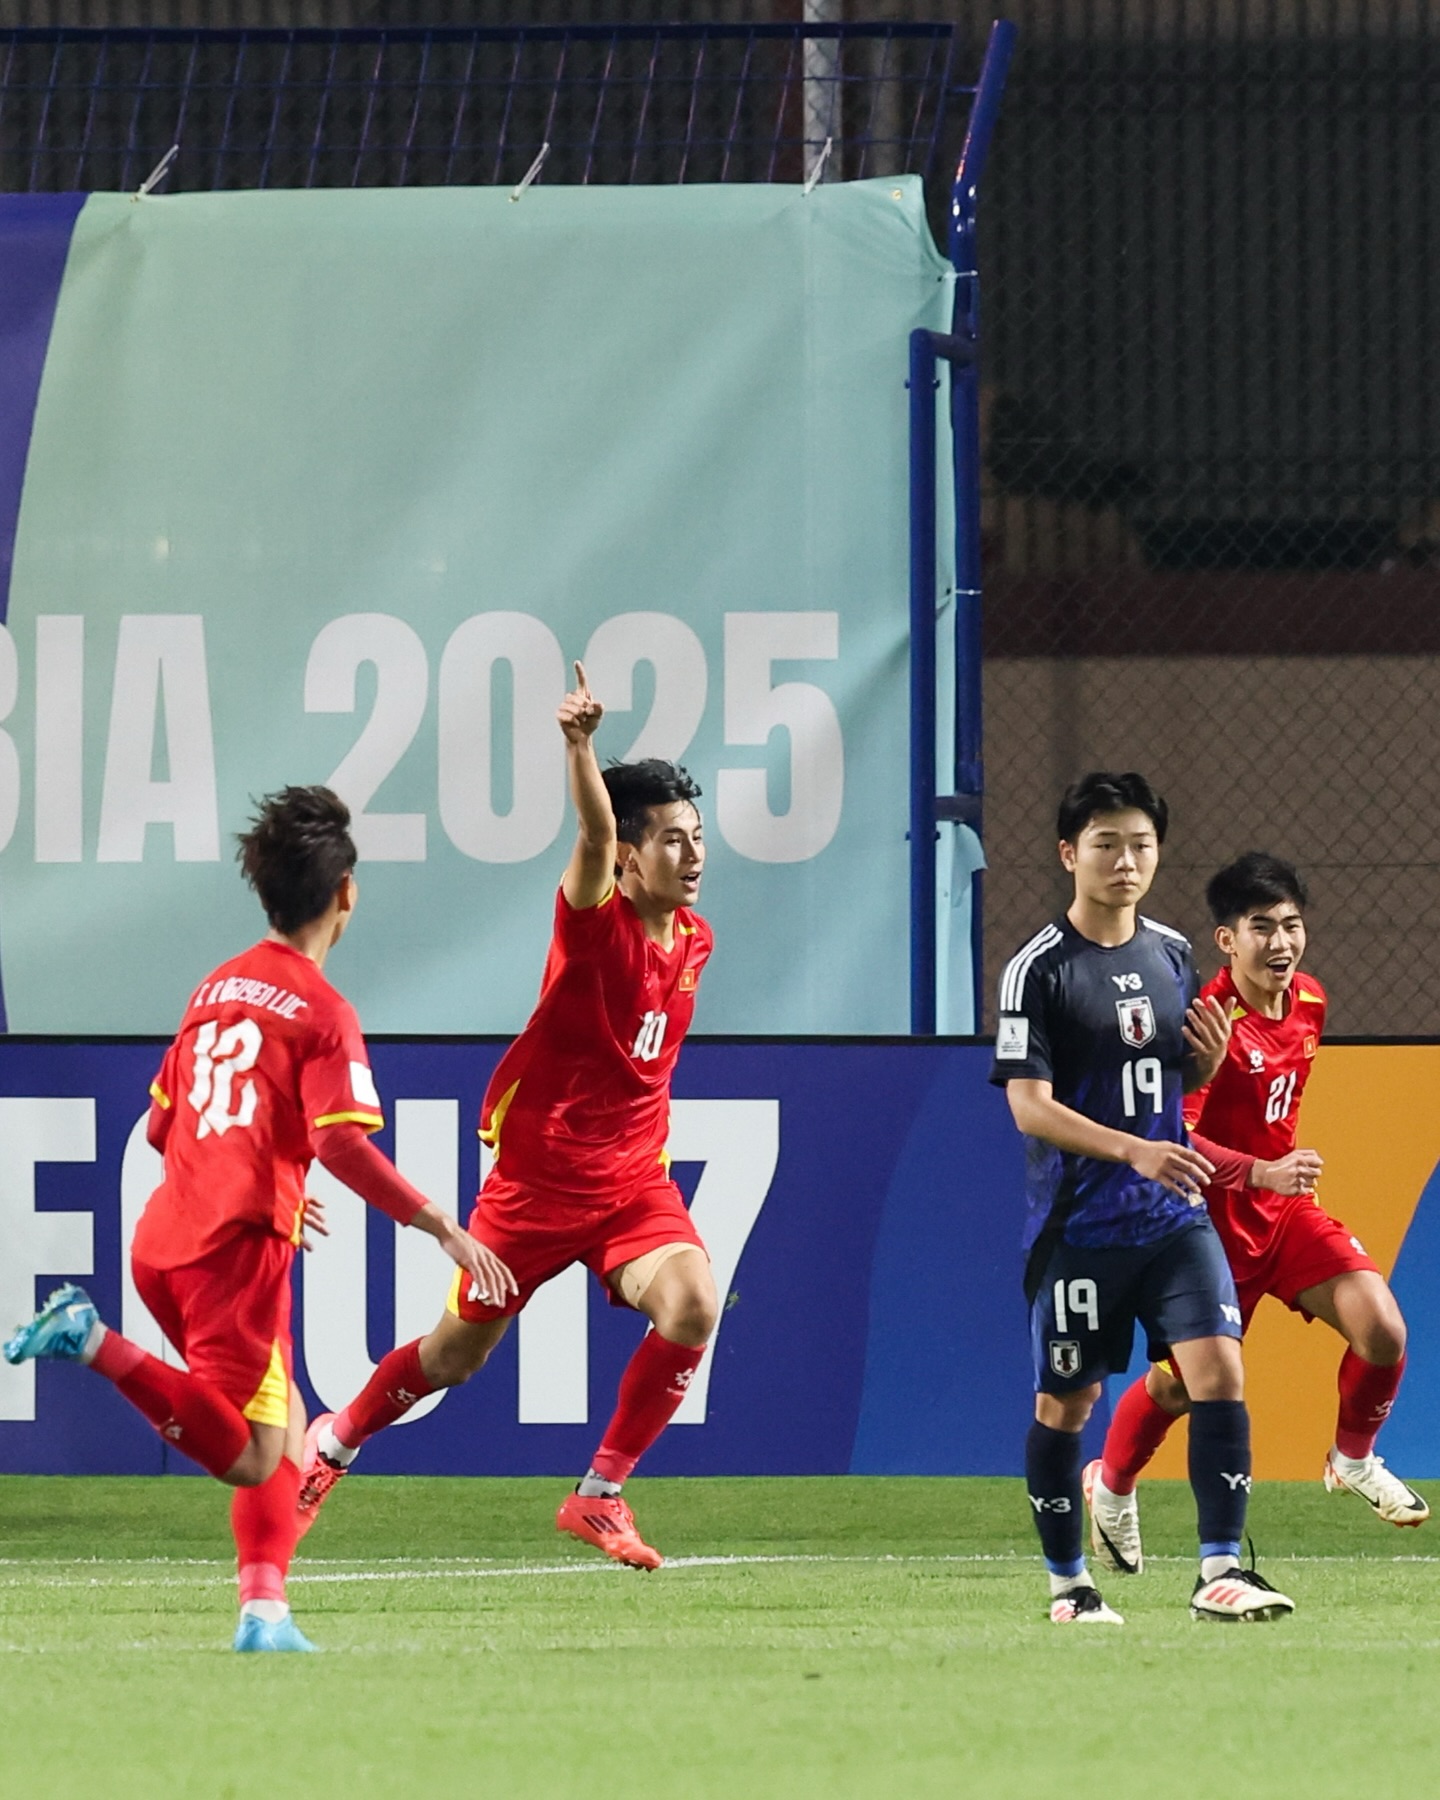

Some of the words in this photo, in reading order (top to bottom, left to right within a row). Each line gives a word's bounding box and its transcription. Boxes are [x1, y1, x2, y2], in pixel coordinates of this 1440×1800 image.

[0, 613, 221, 862] IA
[304, 610, 844, 864] 2025
[266, 989, 308, 1020] LUC
[1111, 972, 1143, 993] Y-3
[630, 1010, 668, 1063] 10
[187, 1017, 264, 1140] 12
[1122, 1057, 1163, 1117] 19
[1265, 1070, 1297, 1125] 21
[1054, 1278, 1100, 1333] 19
[1028, 1494, 1072, 1513] Y-3
